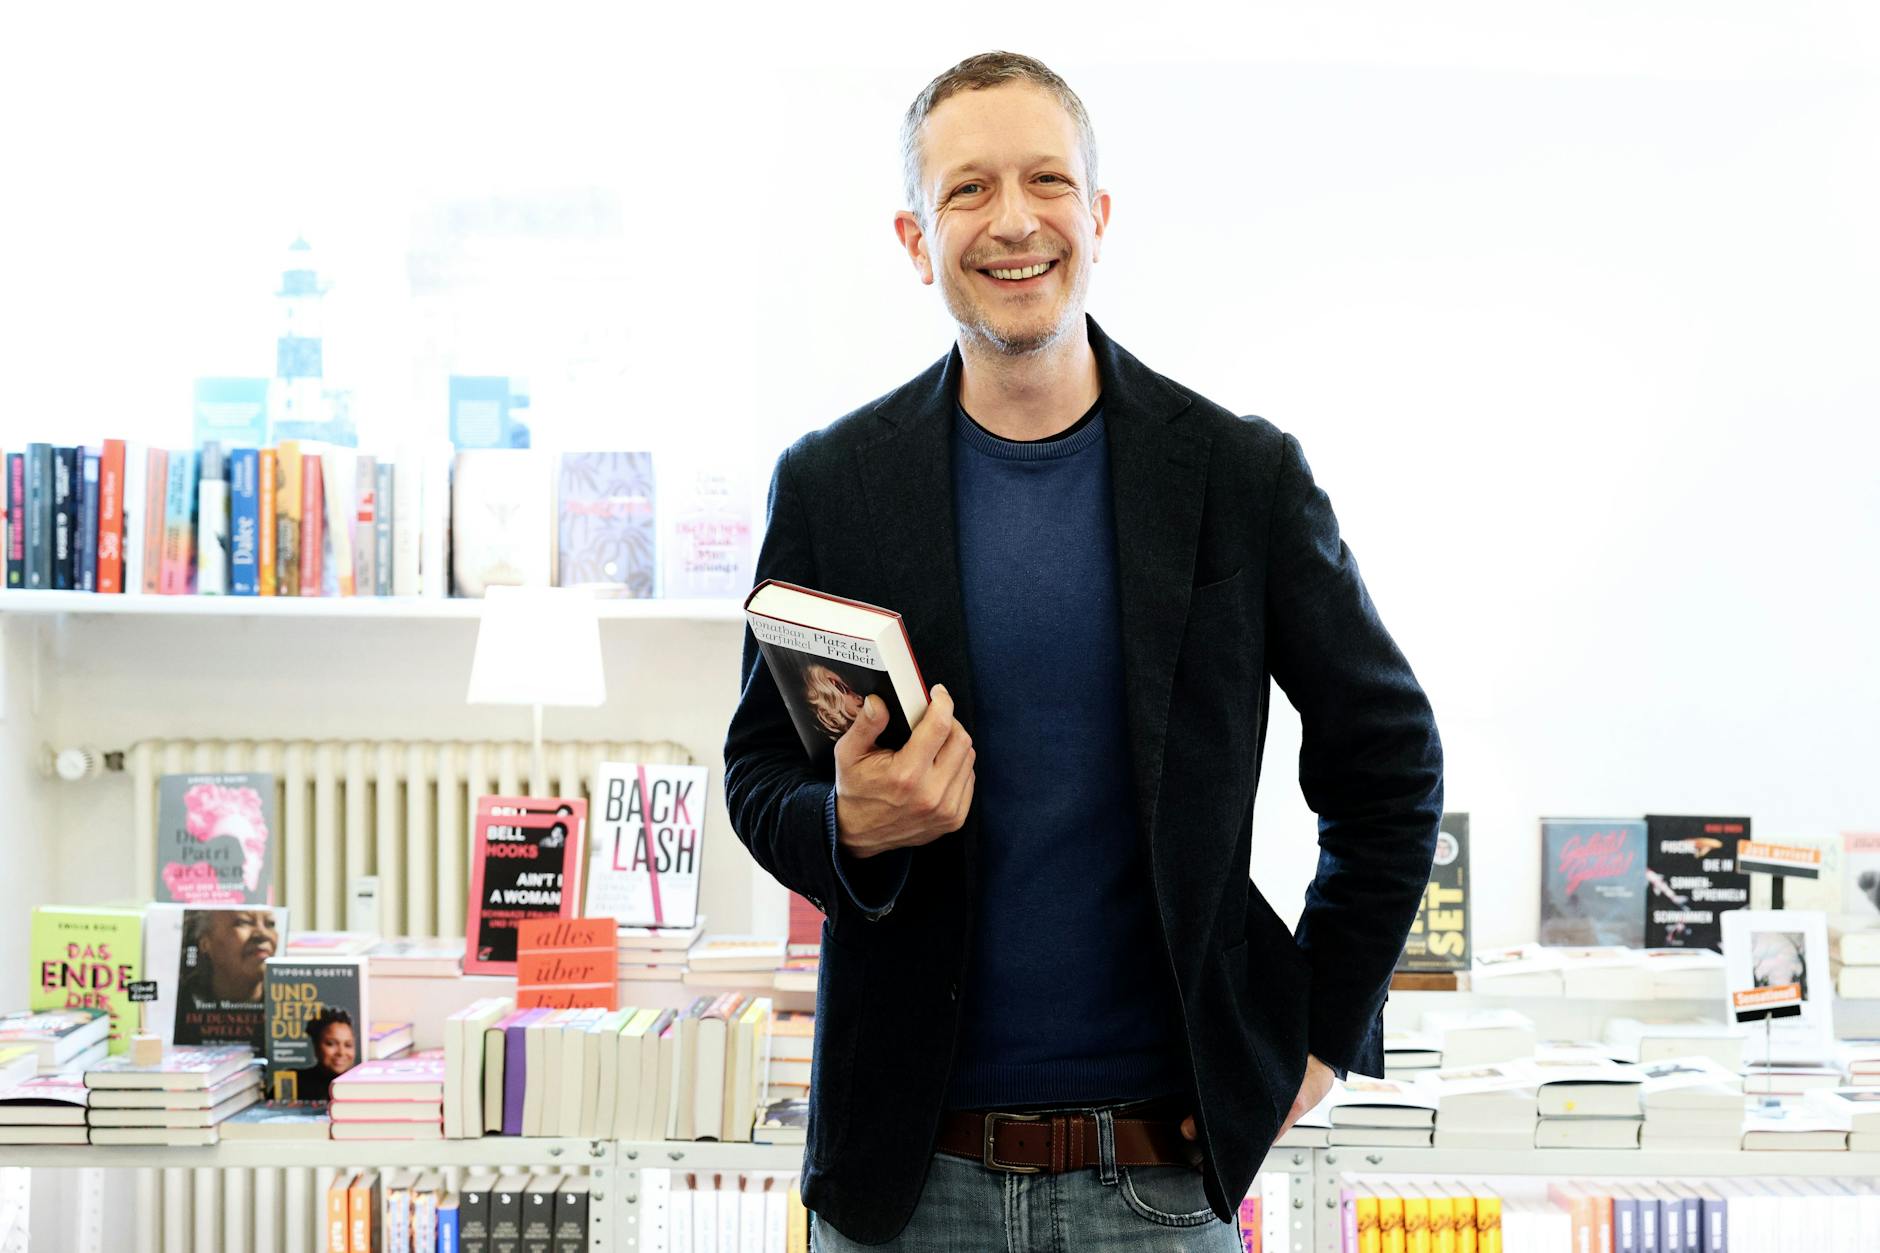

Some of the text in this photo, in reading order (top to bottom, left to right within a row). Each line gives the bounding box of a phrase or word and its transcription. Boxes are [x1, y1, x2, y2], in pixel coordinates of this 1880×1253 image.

[752, 617, 805, 638] Jonathan
[754, 627, 811, 650] Garfinkel
[813, 633, 872, 654] Platz der
[827, 646, 876, 665] Freiheit
[605, 778, 694, 825] BACK
[487, 825, 526, 842] BELL
[181, 846, 230, 861] Patri
[486, 843, 539, 859] HOOKS
[612, 826, 696, 873] LASH
[173, 864, 243, 879] archen
[1702, 859, 1734, 872] DIE IN
[516, 872, 556, 888] AIN'T
[489, 889, 562, 906] A WOMAN
[1428, 881, 1465, 956] SET
[536, 921, 596, 946] alles
[66, 943, 113, 960] DAS
[42, 961, 134, 992] ENDE
[535, 957, 595, 982] über
[271, 983, 318, 1001] UND
[271, 1001, 324, 1020] JETZT
[271, 1020, 309, 1040] DU.
